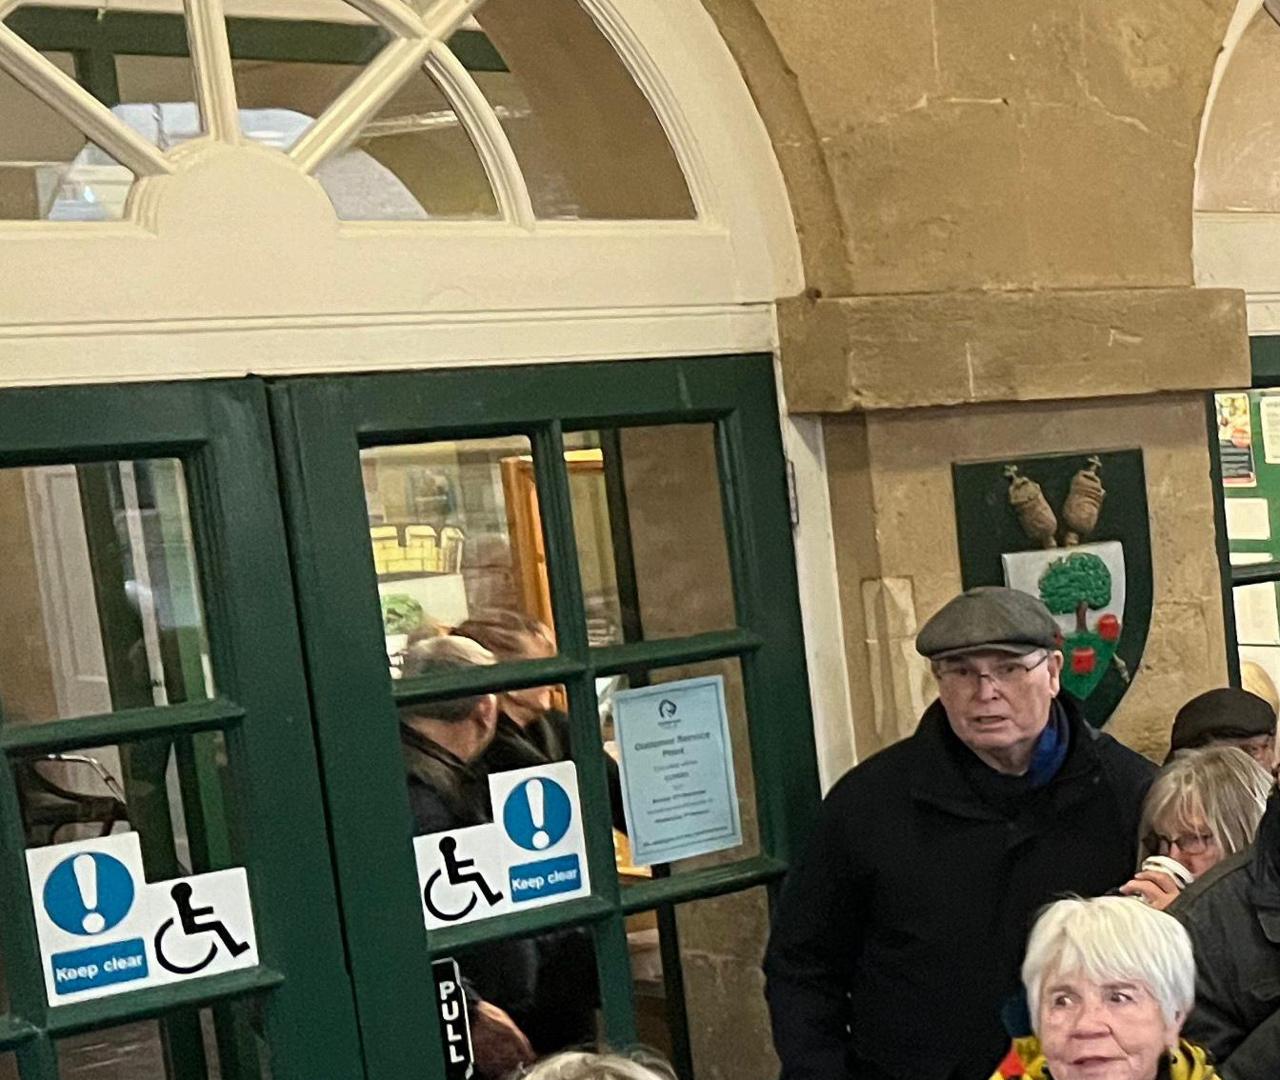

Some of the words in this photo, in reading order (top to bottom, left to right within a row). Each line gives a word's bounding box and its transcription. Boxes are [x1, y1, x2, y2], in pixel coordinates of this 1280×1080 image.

[511, 875, 545, 892] Keep
[547, 867, 578, 885] clear
[55, 963, 99, 983] Keep
[103, 954, 144, 973] clear
[439, 980, 465, 1064] PULL
